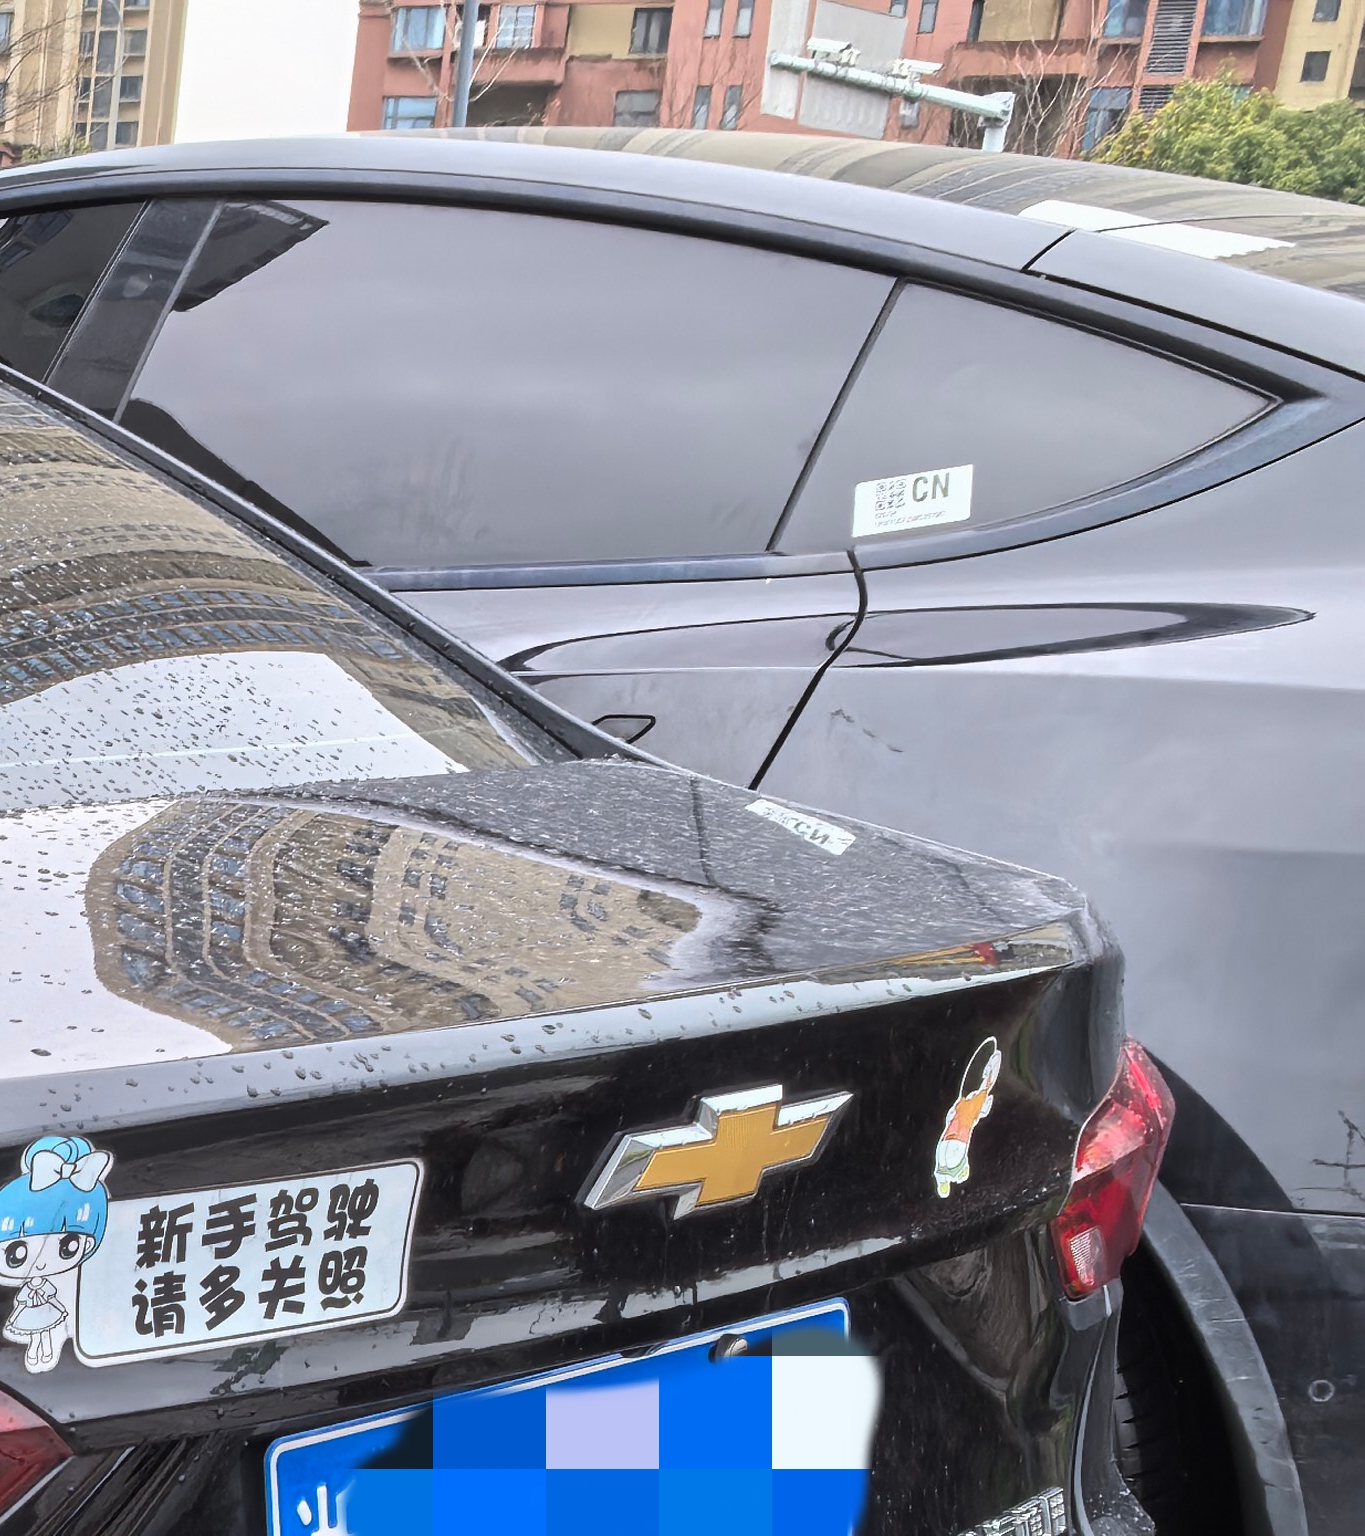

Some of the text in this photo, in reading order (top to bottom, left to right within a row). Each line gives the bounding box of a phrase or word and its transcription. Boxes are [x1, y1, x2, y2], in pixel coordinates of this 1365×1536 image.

[912, 472, 950, 502] CN
[136, 1178, 380, 1268] 新手驾驶
[132, 1246, 368, 1338] 请多关照
